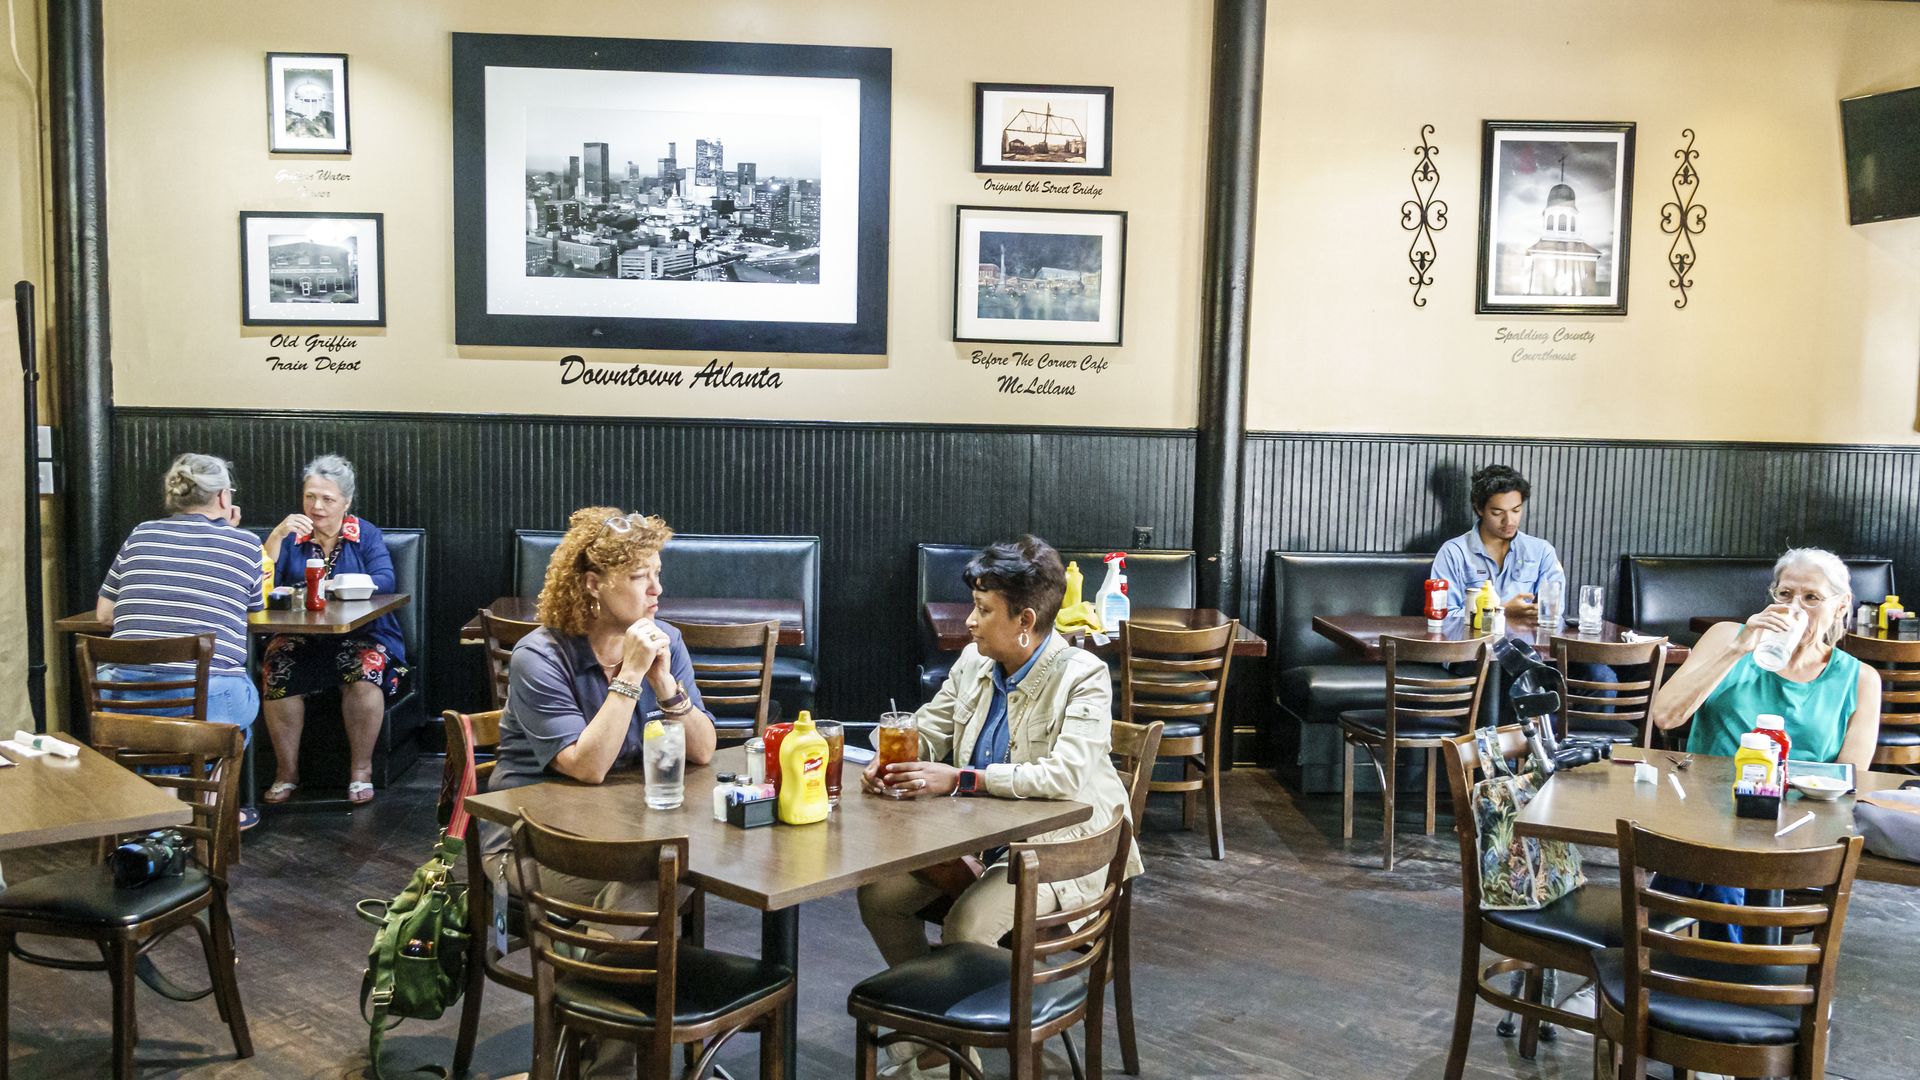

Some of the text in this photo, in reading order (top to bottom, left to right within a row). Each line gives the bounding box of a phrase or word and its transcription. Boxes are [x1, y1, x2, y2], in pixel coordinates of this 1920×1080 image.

[316, 169, 351, 181] Water
[983, 178, 1103, 199] Original 6th Street Bridge
[270, 333, 358, 352] Old Griffin
[1494, 326, 1596, 344] Spalding County
[971, 350, 1110, 374] Before The Corner Cafe
[1511, 346, 1577, 363] Courthouse
[265, 356, 362, 374] Train Depot
[559, 354, 784, 389] Downtown Atlanta
[997, 374, 1077, 396] McLellans
